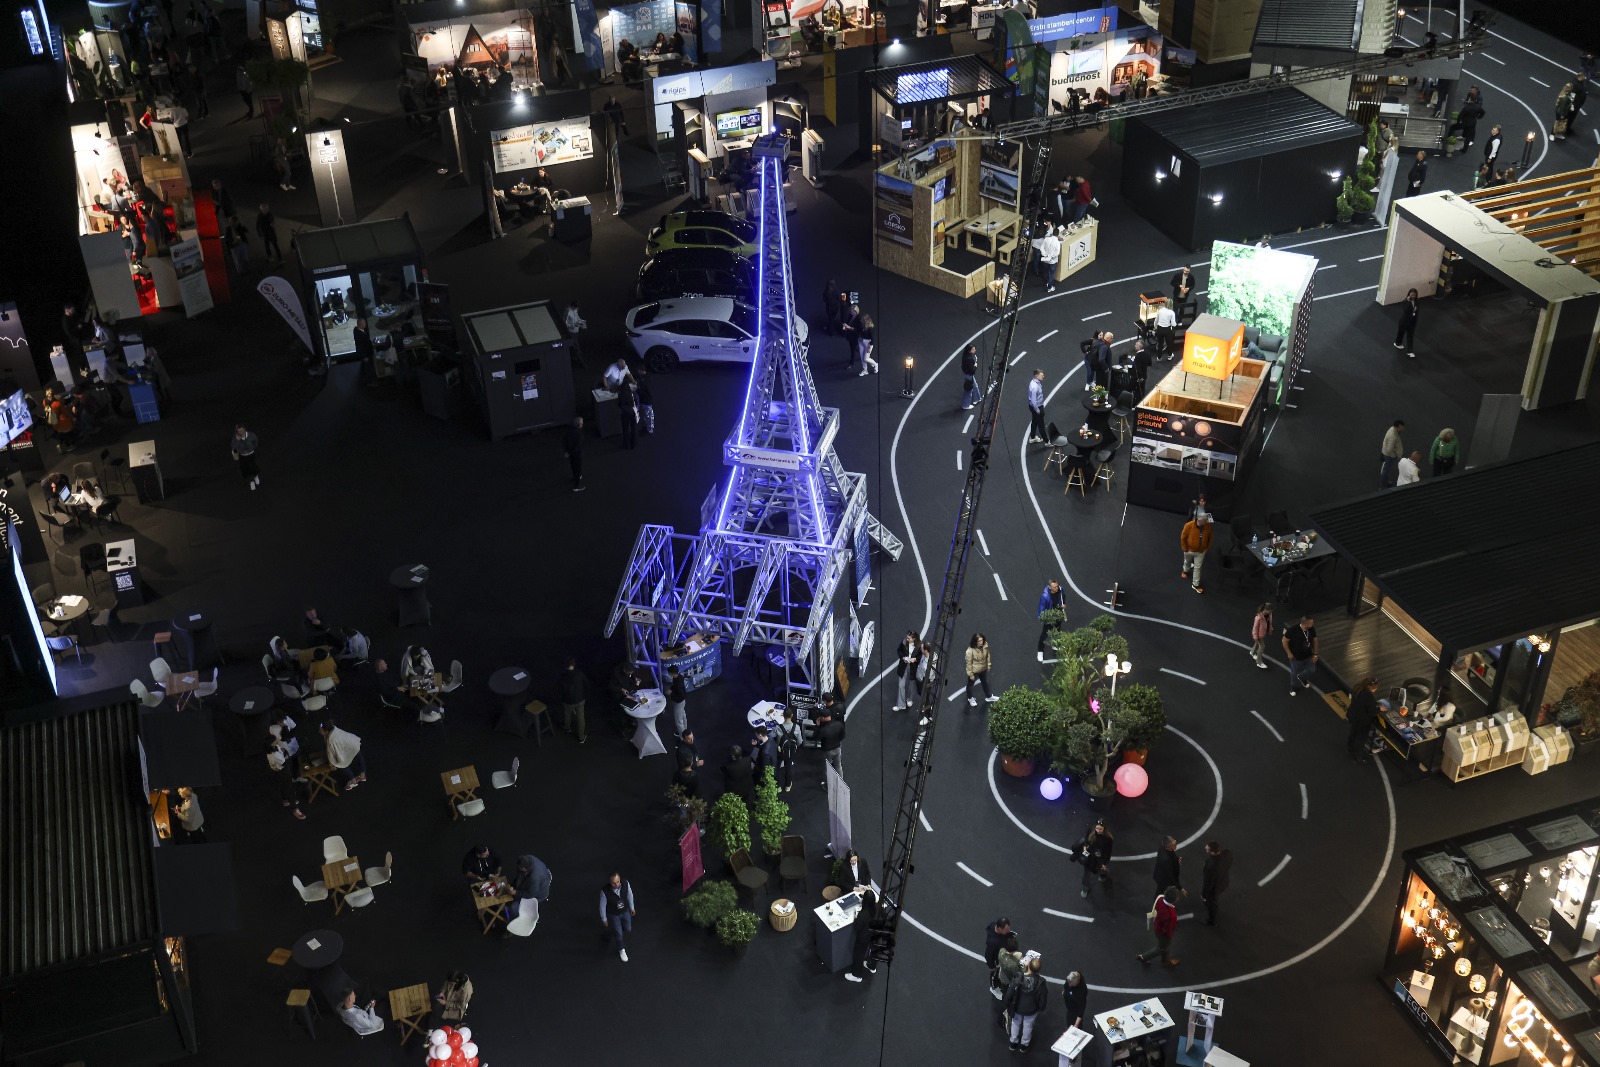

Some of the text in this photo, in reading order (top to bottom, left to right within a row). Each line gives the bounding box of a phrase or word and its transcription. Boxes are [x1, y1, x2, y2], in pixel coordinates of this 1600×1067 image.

[979, 12, 995, 20] HDL
[636, 23, 653, 32] PAR
[1051, 71, 1101, 87] budućnost
[1137, 412, 1168, 423] globalno
[1406, 994, 1428, 1023] EGLO
